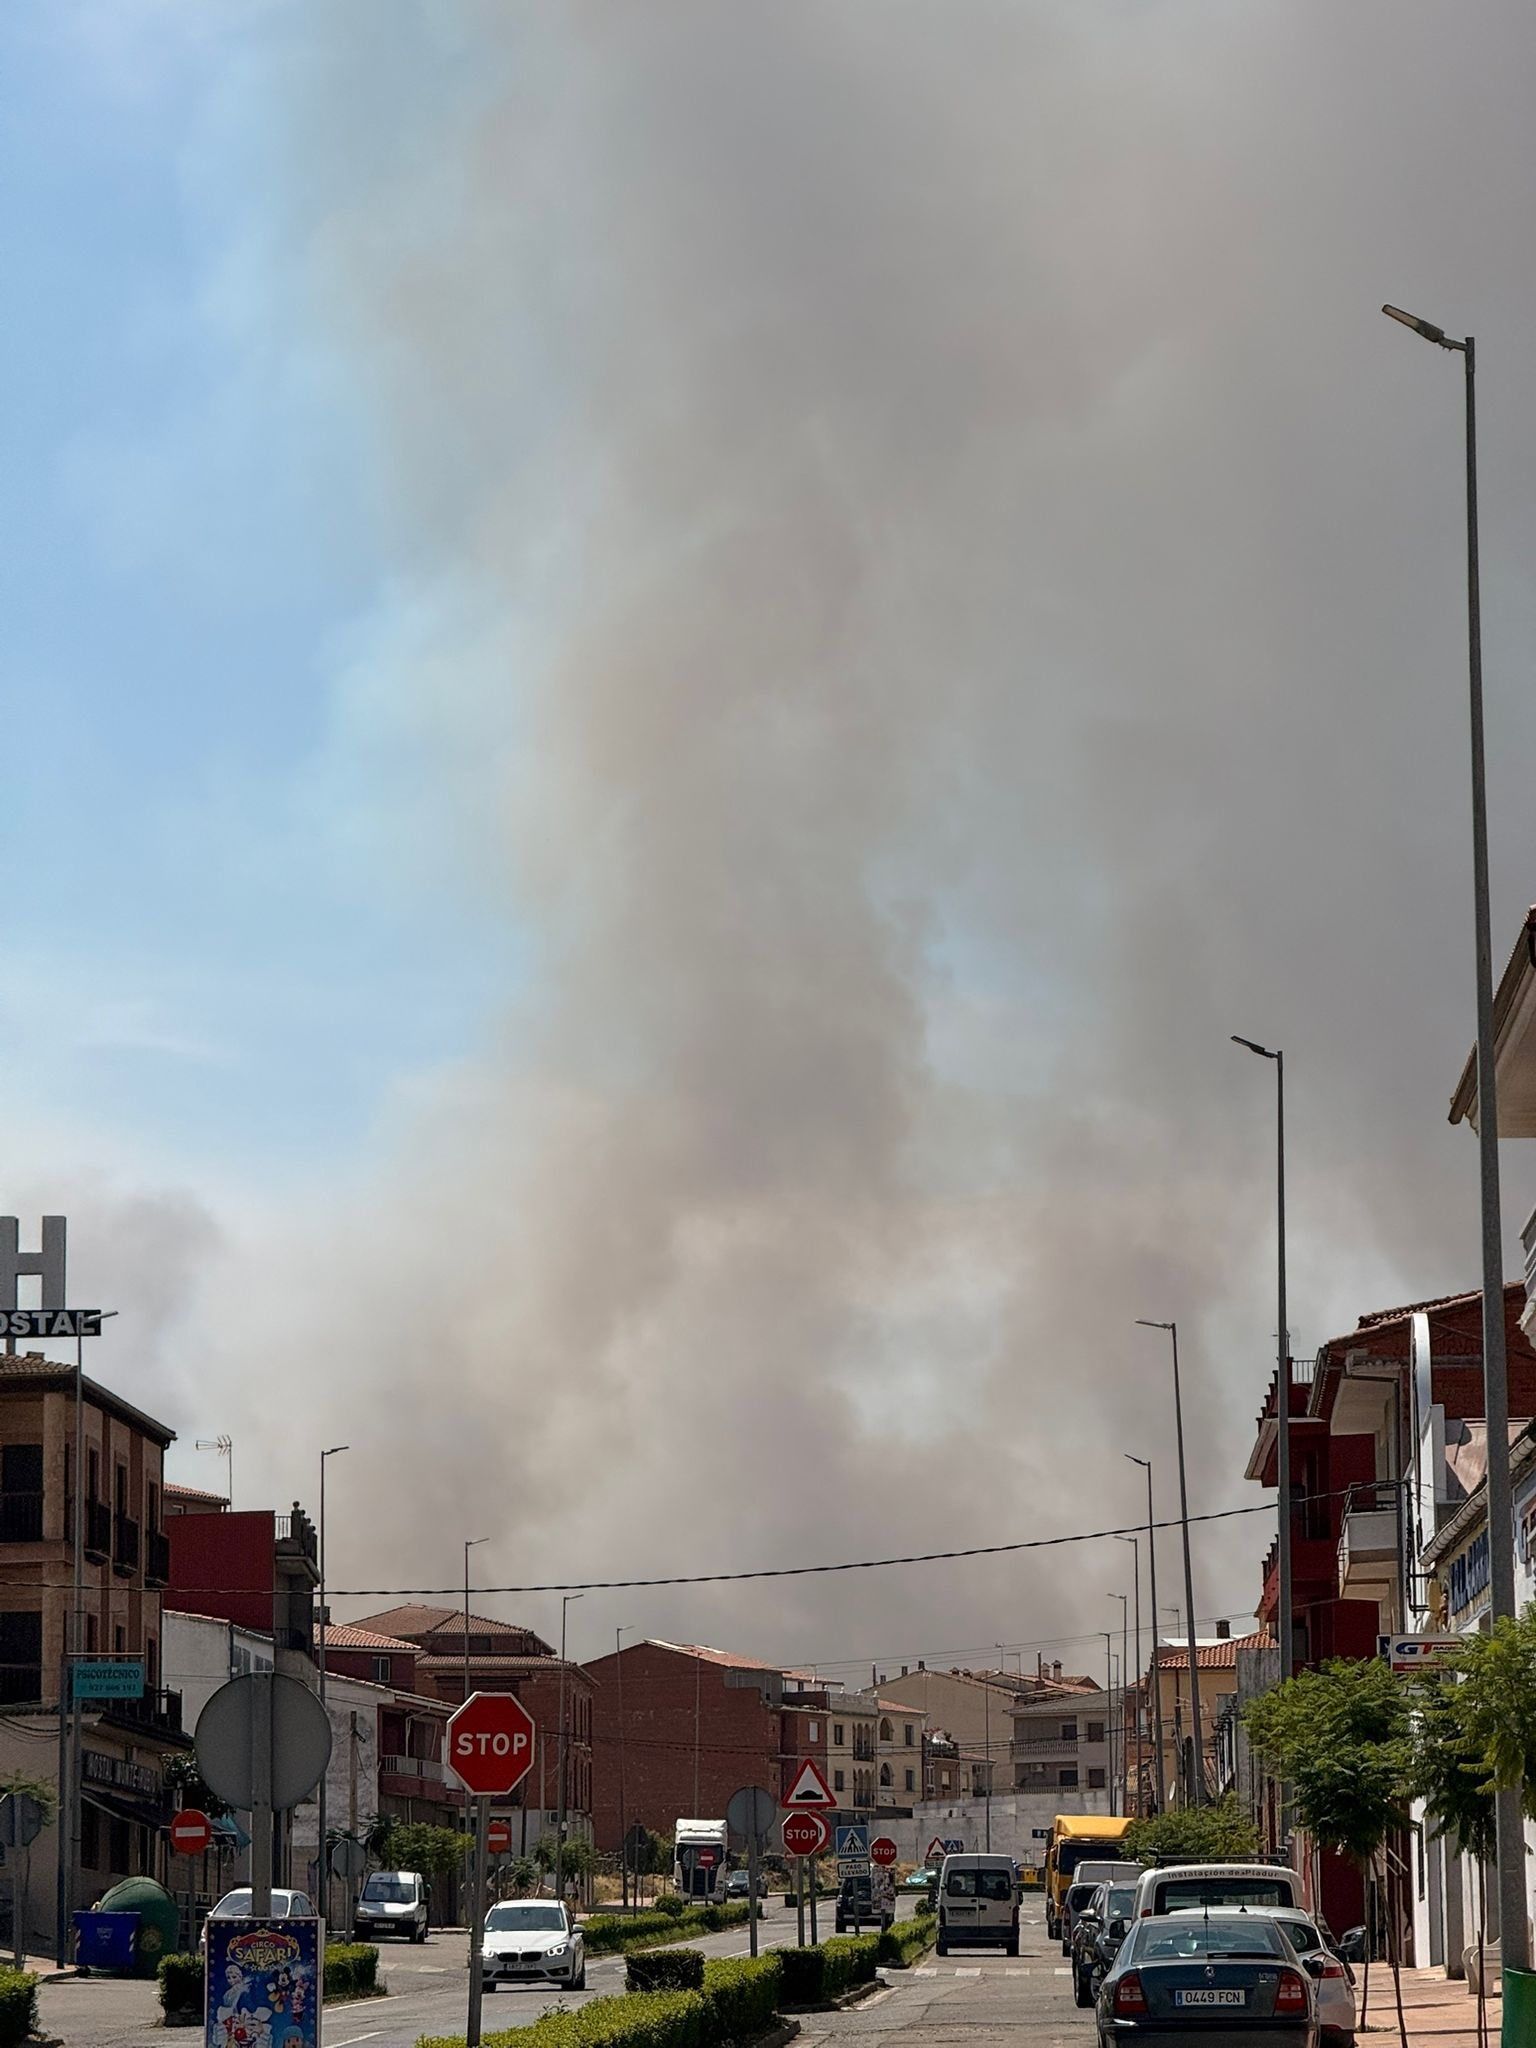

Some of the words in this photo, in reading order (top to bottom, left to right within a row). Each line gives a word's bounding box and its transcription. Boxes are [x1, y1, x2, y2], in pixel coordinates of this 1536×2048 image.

[456, 1732, 528, 1756] STOP
[785, 1829, 817, 1840] STOP
[872, 1847, 896, 1856] STOP
[1245, 1869, 1279, 1878] Pladur
[235, 1947, 291, 1962] SAFARI
[1185, 1991, 1215, 2004] 0449
[1218, 1991, 1241, 2003] FCN
